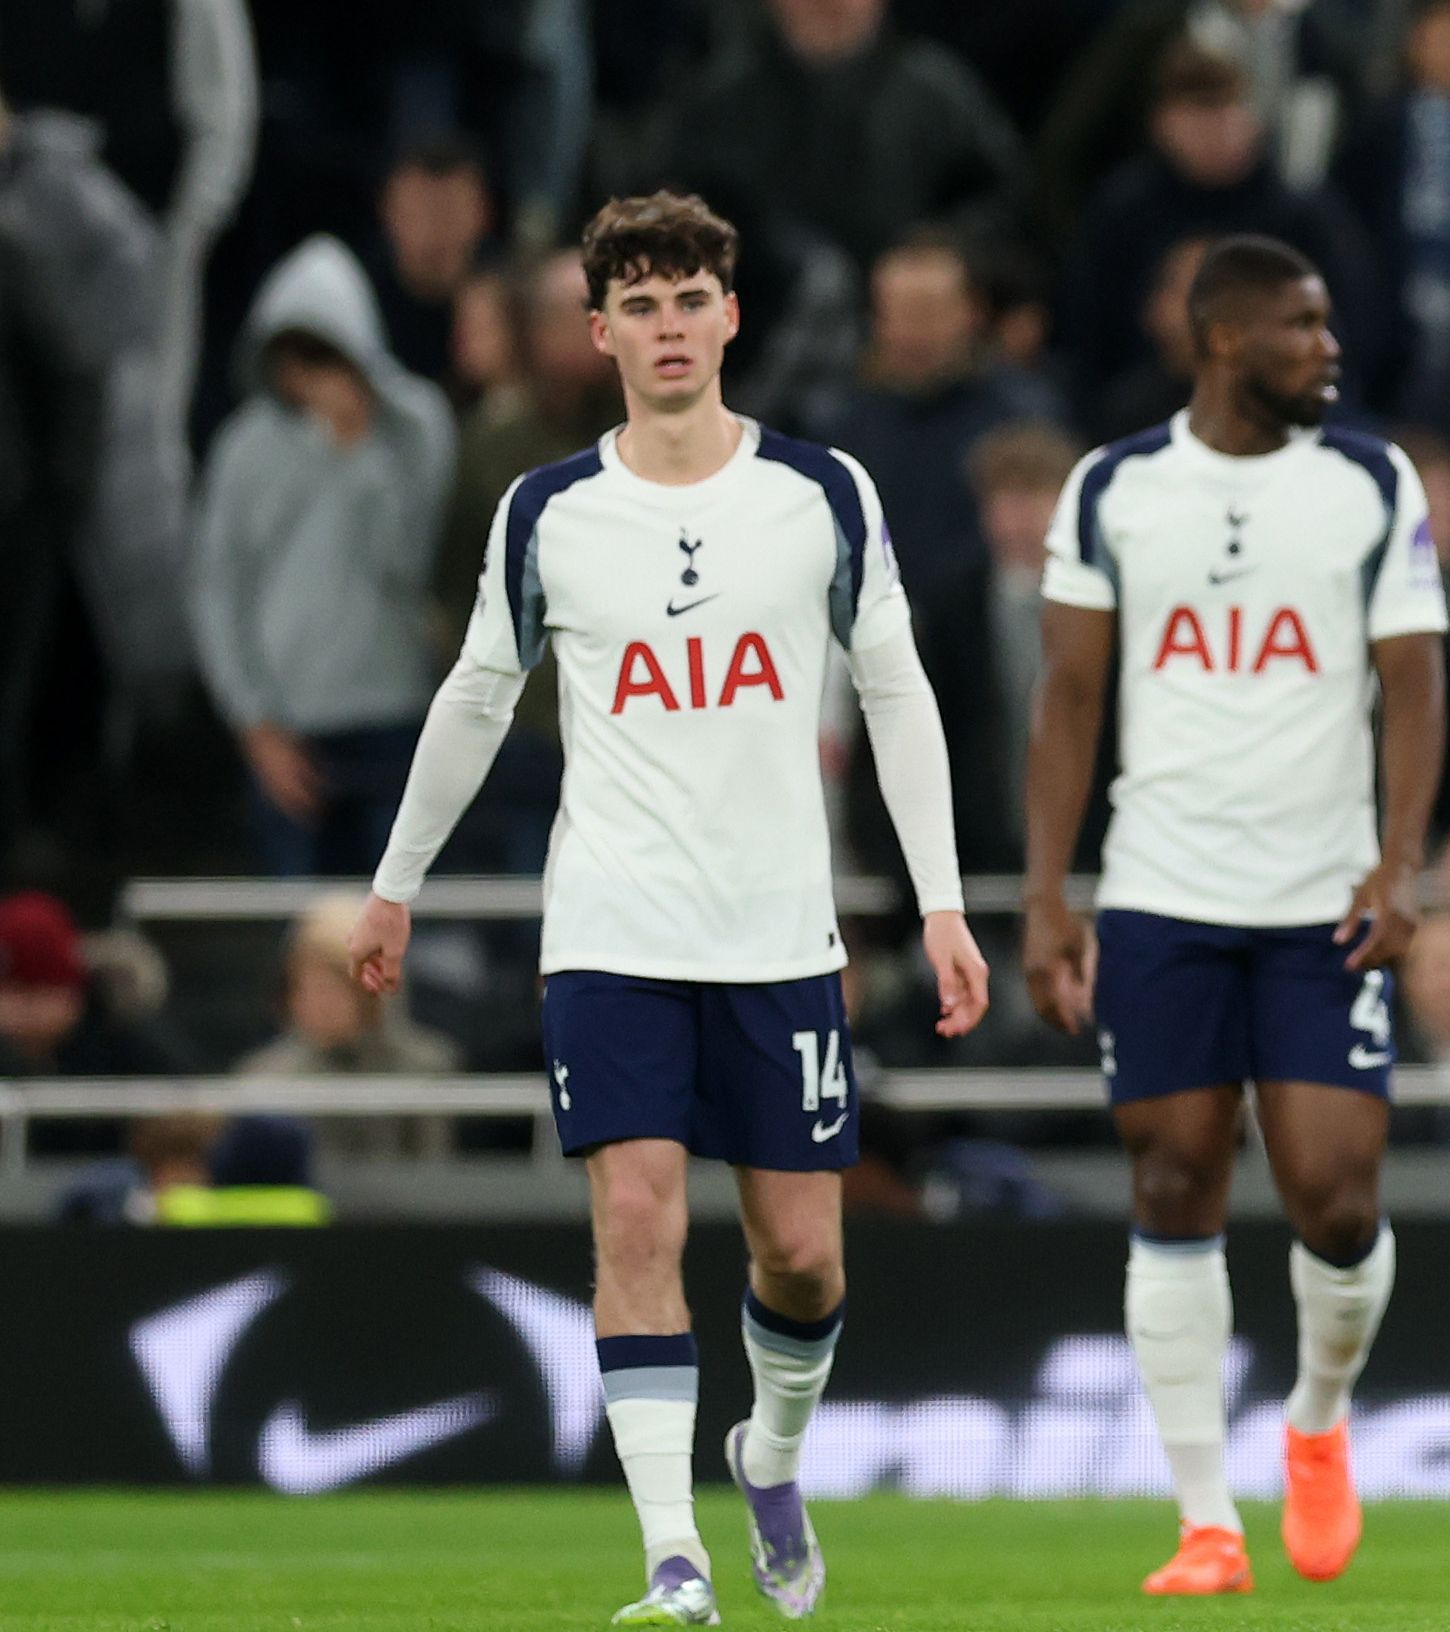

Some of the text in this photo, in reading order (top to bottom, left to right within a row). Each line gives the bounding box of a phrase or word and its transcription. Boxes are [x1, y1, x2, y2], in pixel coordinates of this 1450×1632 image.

[610, 631, 785, 715] AIA
[1152, 604, 1321, 675] AIA
[1349, 968, 1391, 1048] 4
[792, 1029, 848, 1111] 14
